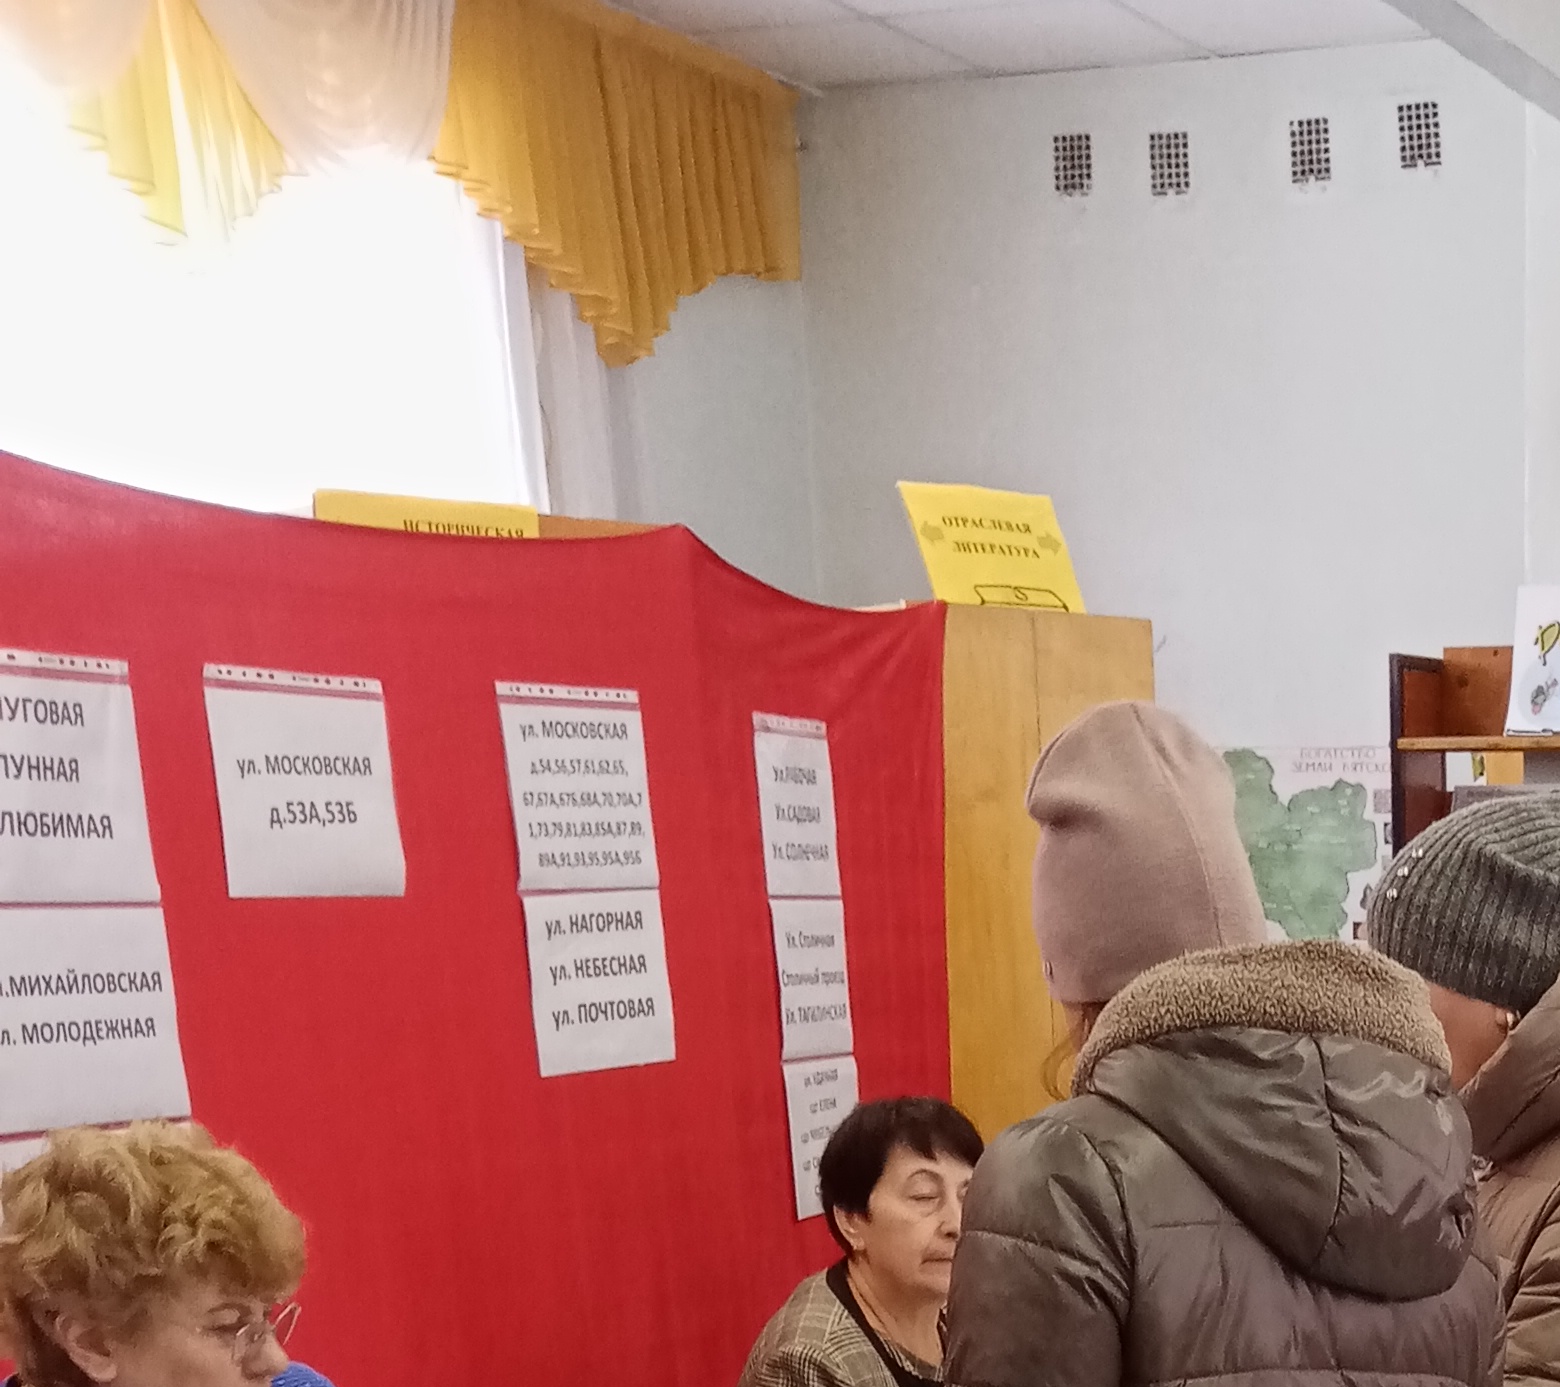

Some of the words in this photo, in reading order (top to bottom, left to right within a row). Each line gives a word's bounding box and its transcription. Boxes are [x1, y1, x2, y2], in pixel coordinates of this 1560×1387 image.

[942, 515, 1031, 534] ОТРАСЛЕВАЯ
[952, 541, 1040, 559] ЛИТЕРАТУРА
[0, 695, 85, 727] УГОВАЯ
[520, 724, 539, 742] ул.
[541, 720, 628, 740] МОСКОВСКАЯ
[236, 759, 261, 779] ул.
[265, 754, 372, 776] МОСКОВСКАЯ
[0, 811, 113, 840] ЛЮБИМАЯ
[545, 920, 566, 941] ул.
[569, 910, 643, 934] НАГОРНАЯ
[549, 965, 571, 986] ул.
[574, 954, 647, 978] НЕБЕСНАЯ
[552, 1010, 574, 1031] ул.
[578, 997, 655, 1024] ПОЧТОВАЯ
[21, 1017, 156, 1047] МОЛОДЕЖНАЯ
